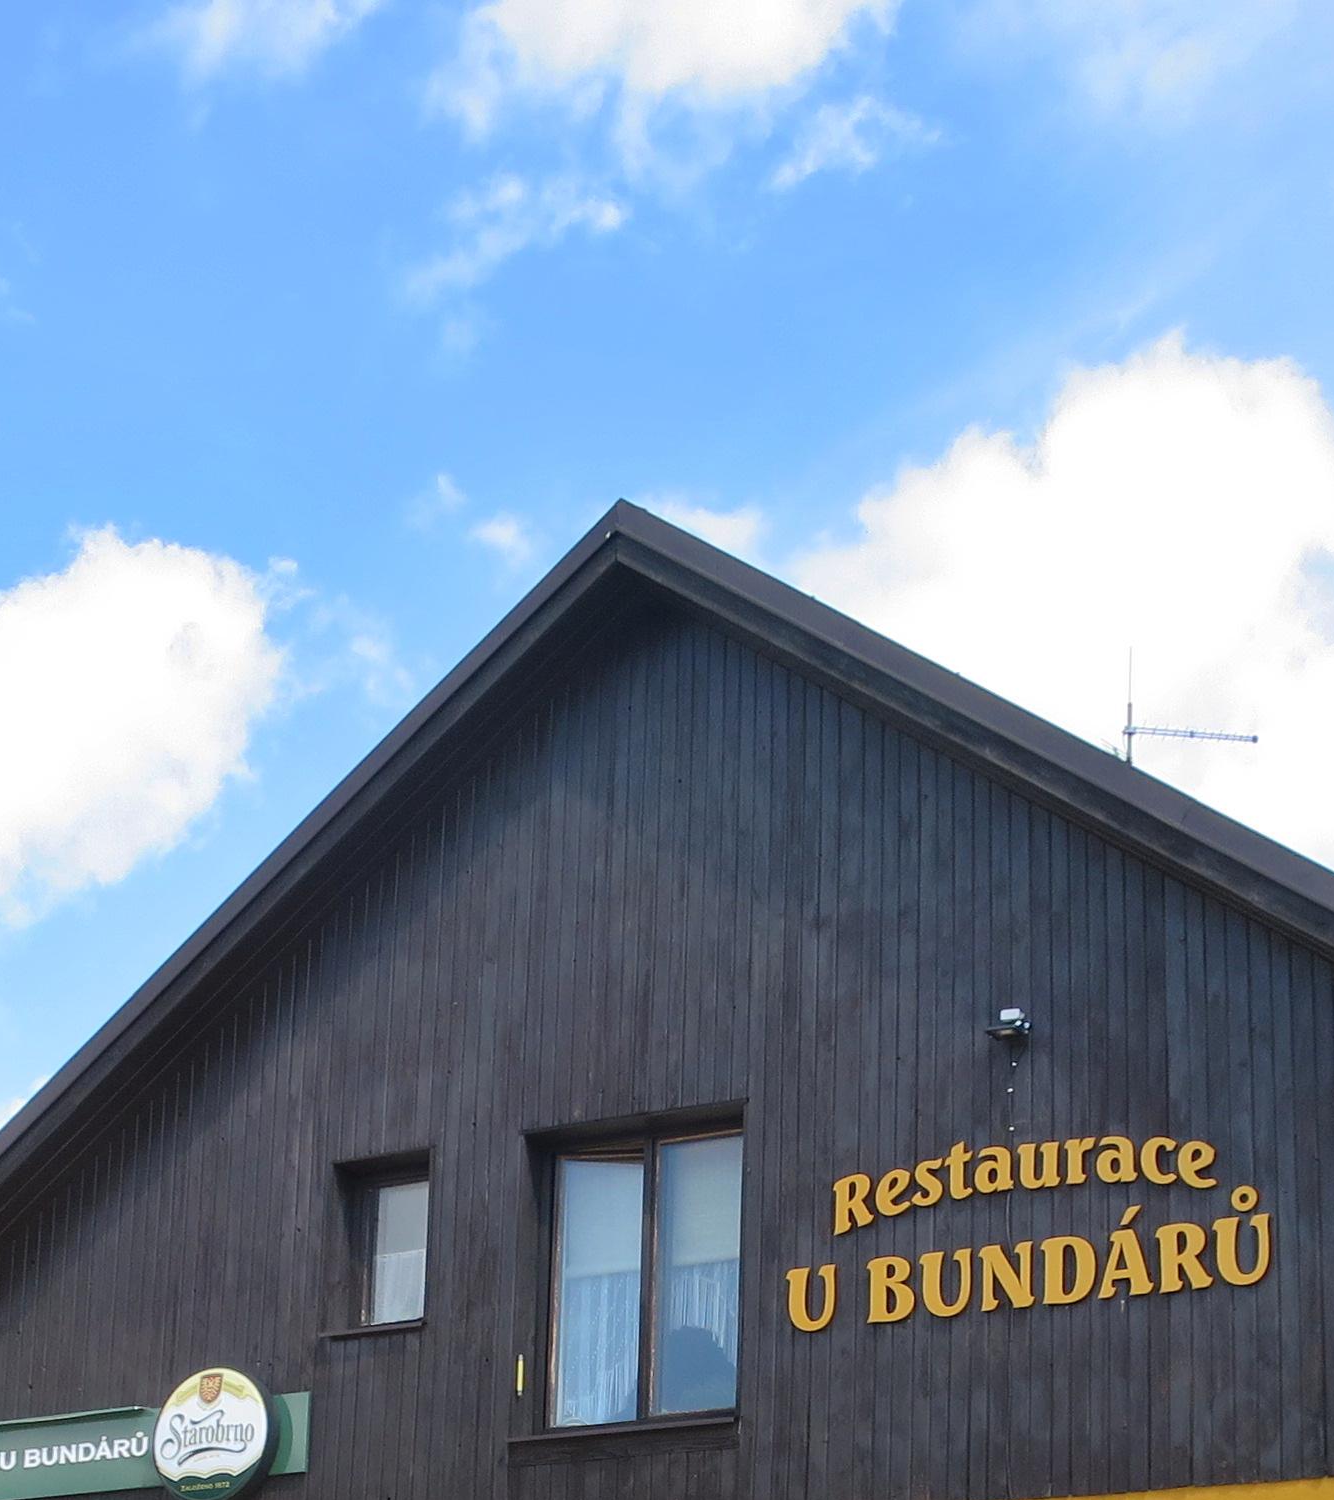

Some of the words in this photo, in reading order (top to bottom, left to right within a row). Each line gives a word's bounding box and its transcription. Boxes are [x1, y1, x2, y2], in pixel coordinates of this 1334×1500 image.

[831, 1135, 1219, 1236] Restaurace
[785, 1263, 838, 1332] U
[865, 1184, 1271, 1325] BUNDÁRŮ
[23, 1431, 149, 1469] BUNDÁRŮ
[160, 1409, 255, 1461] Starobrno
